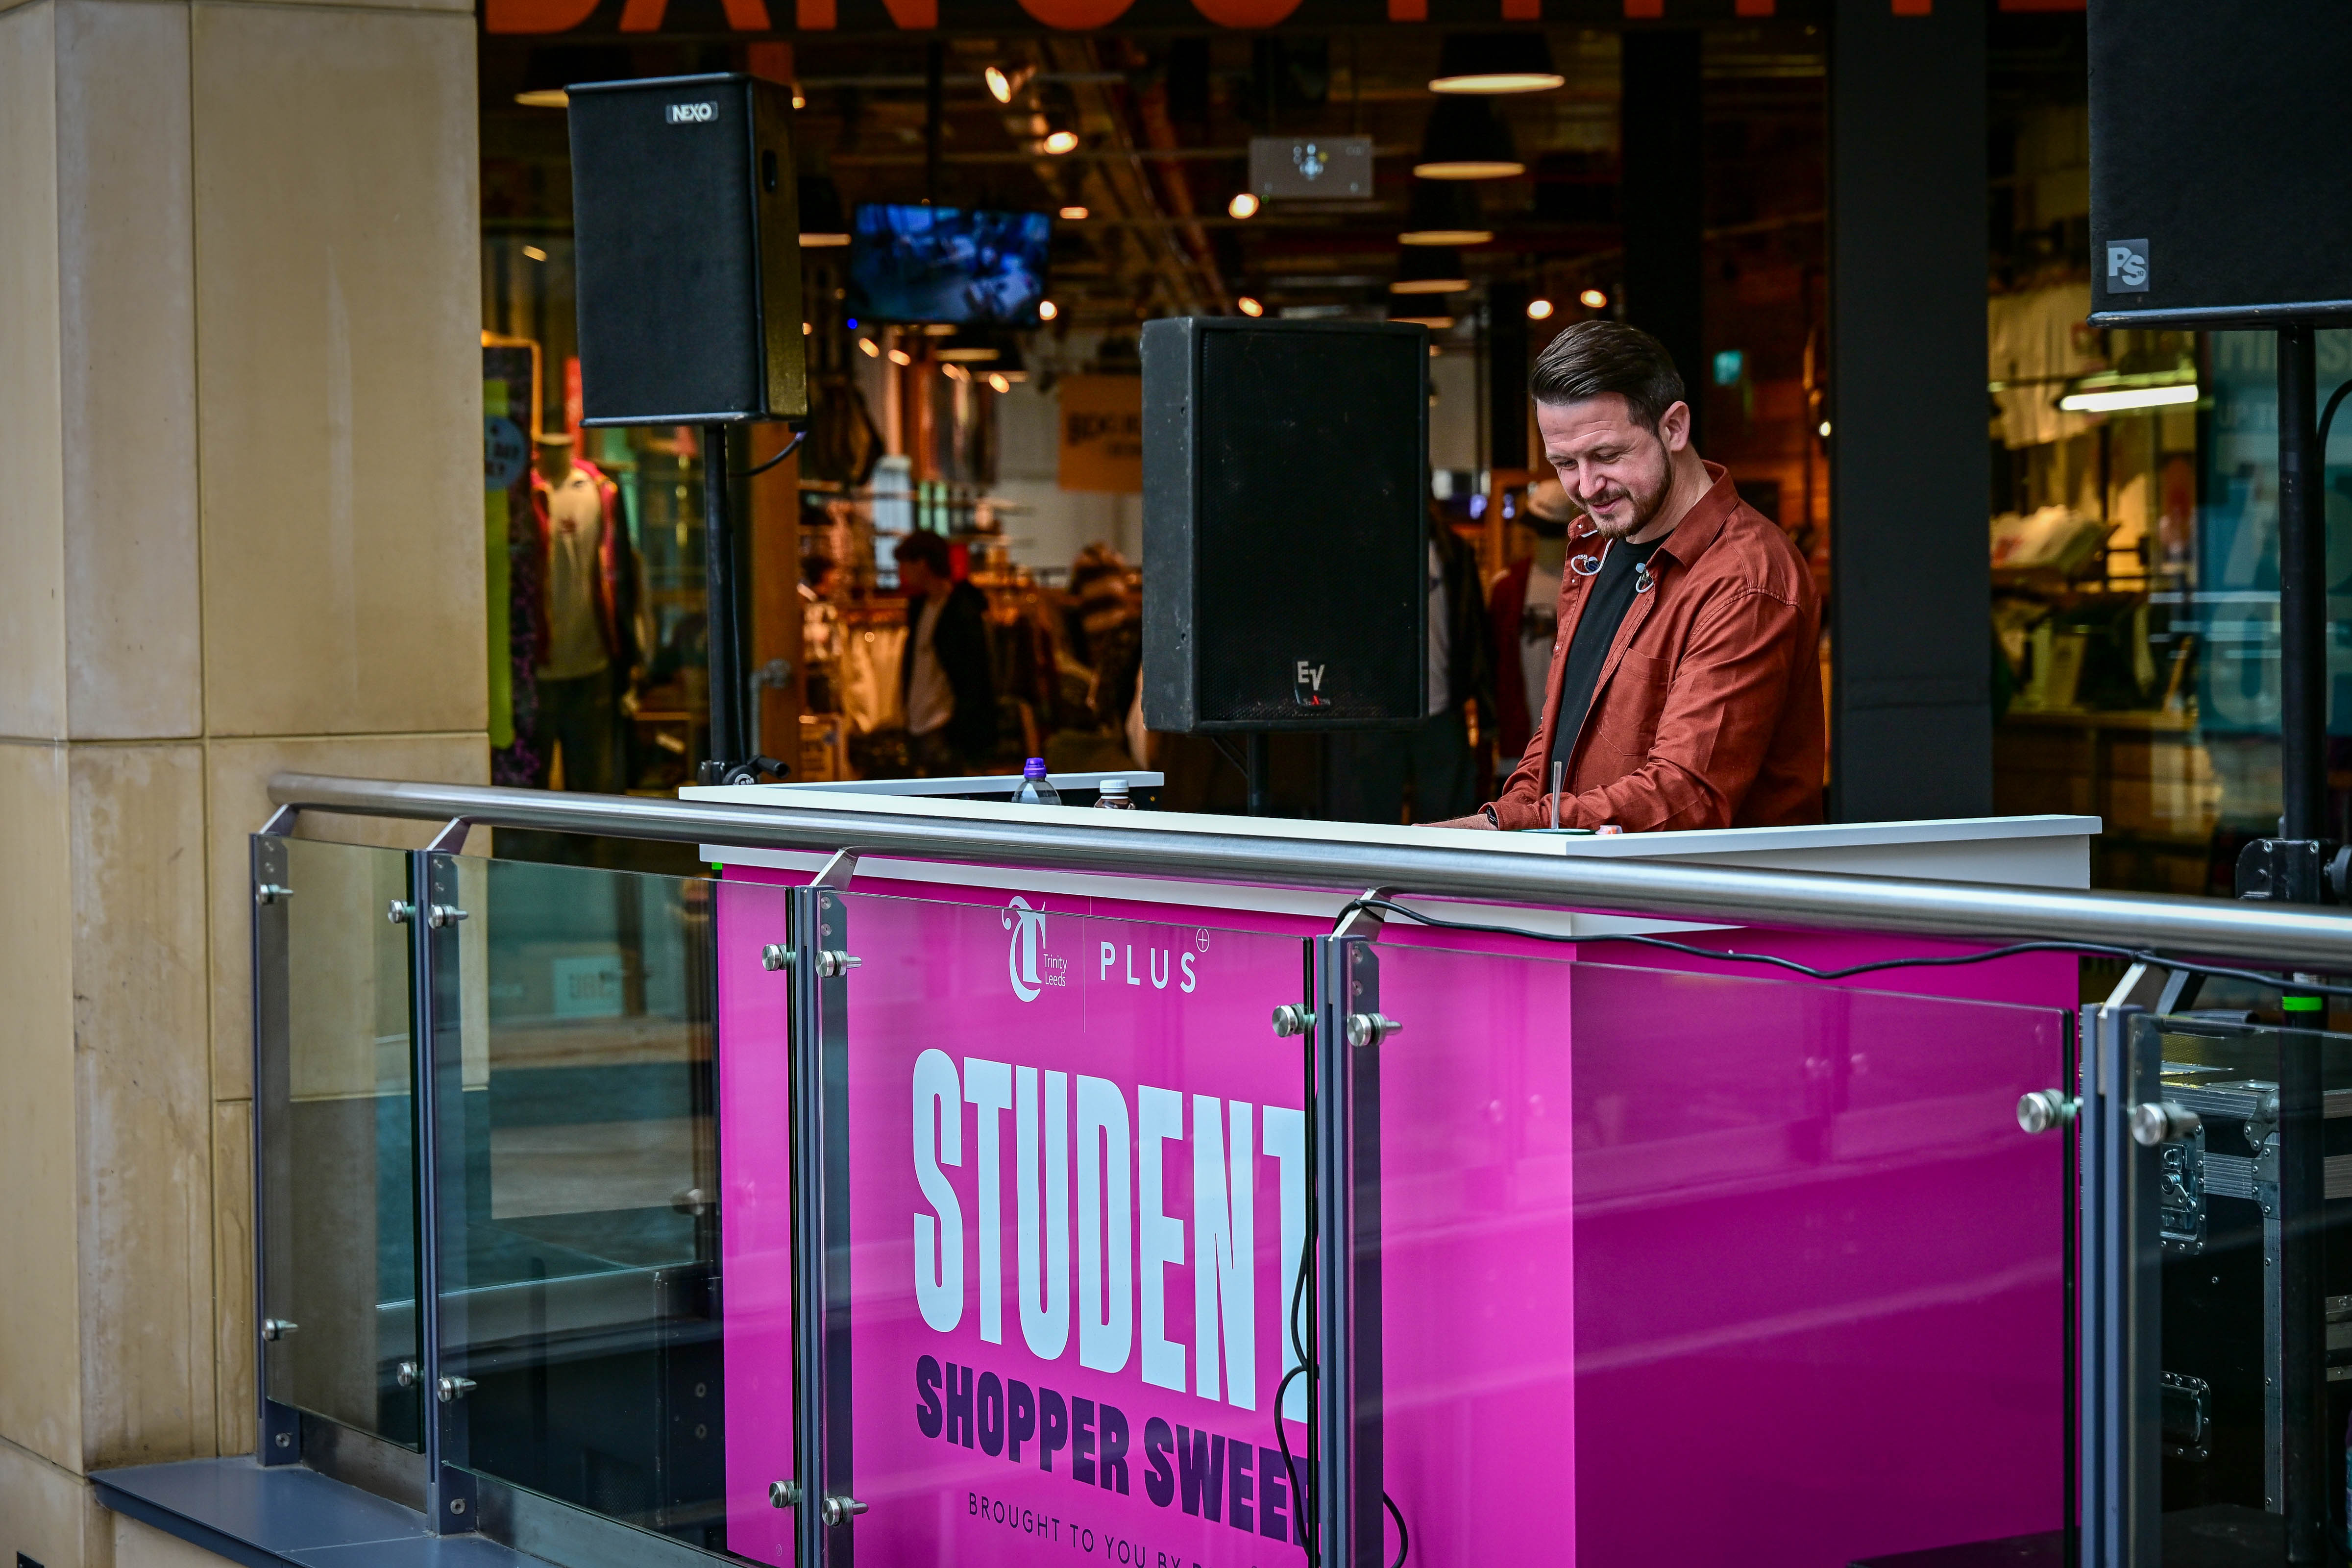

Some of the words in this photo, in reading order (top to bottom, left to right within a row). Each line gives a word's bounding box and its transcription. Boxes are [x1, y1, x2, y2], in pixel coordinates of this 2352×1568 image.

[672, 102, 712, 122] NEXO
[2108, 247, 2147, 286] PS
[1297, 661, 1325, 690] EV
[1043, 954, 1068, 974] Trinity
[1045, 972, 1066, 986] Leeds
[1101, 941, 1196, 993] PLUS
[916, 1354, 1130, 1496] SHOPPER
[969, 1492, 1060, 1542] BROUGHT
[1070, 1524, 1094, 1553] TO
[1104, 1535, 1146, 1568] YOU
